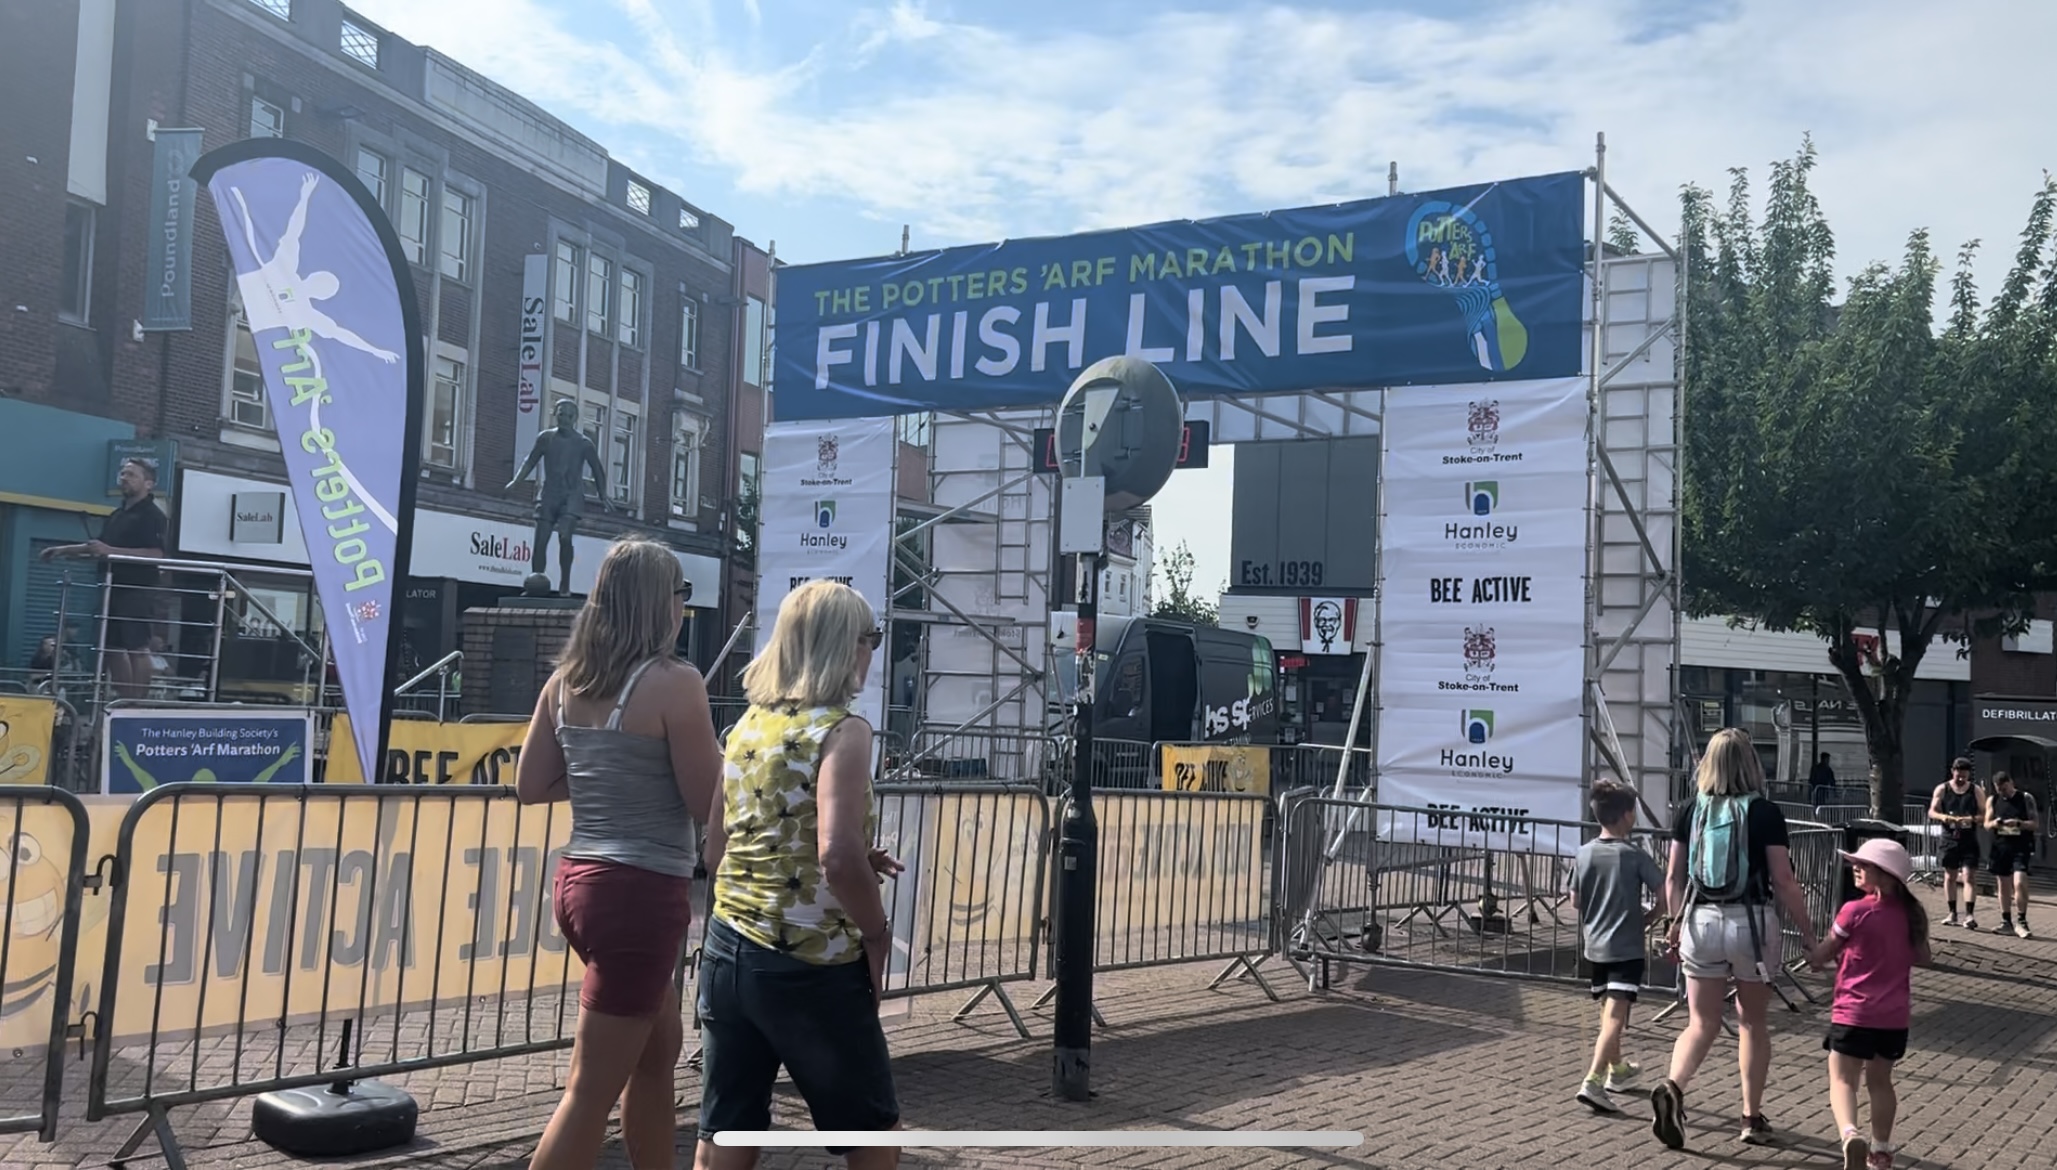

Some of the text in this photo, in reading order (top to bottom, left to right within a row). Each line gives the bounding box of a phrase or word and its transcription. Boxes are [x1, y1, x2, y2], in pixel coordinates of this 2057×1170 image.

[160, 179, 181, 297] Poundland
[815, 286, 871, 316] THE
[882, 267, 1028, 309] POTTERS
[1129, 232, 1354, 283] MARATHON
[815, 275, 1356, 390] FINISH LINE
[518, 297, 545, 414] SaleLab
[1442, 452, 1523, 464] Stoke-on-Trent
[236, 512, 273, 523] SaleLab
[800, 533, 847, 549] Hanley
[1445, 522, 1518, 542] Hanley
[470, 531, 531, 563] SaleLab
[1241, 560, 1323, 586] Est. 1939
[405, 588, 437, 599] LATOR
[1430, 577, 1532, 603] BEE ACTIVE
[1438, 681, 1519, 692] Stoke-on-Trent
[1982, 708, 2057, 720] DEFIBRILLAT
[142, 729, 160, 737] The
[163, 729, 196, 740] Hanley
[200, 729, 238, 739] Building
[136, 745, 187, 756] Potters
[217, 744, 280, 756] Marathon
[1440, 750, 1514, 773] Hanley
[1427, 803, 1530, 835] BEE ACTIVE
